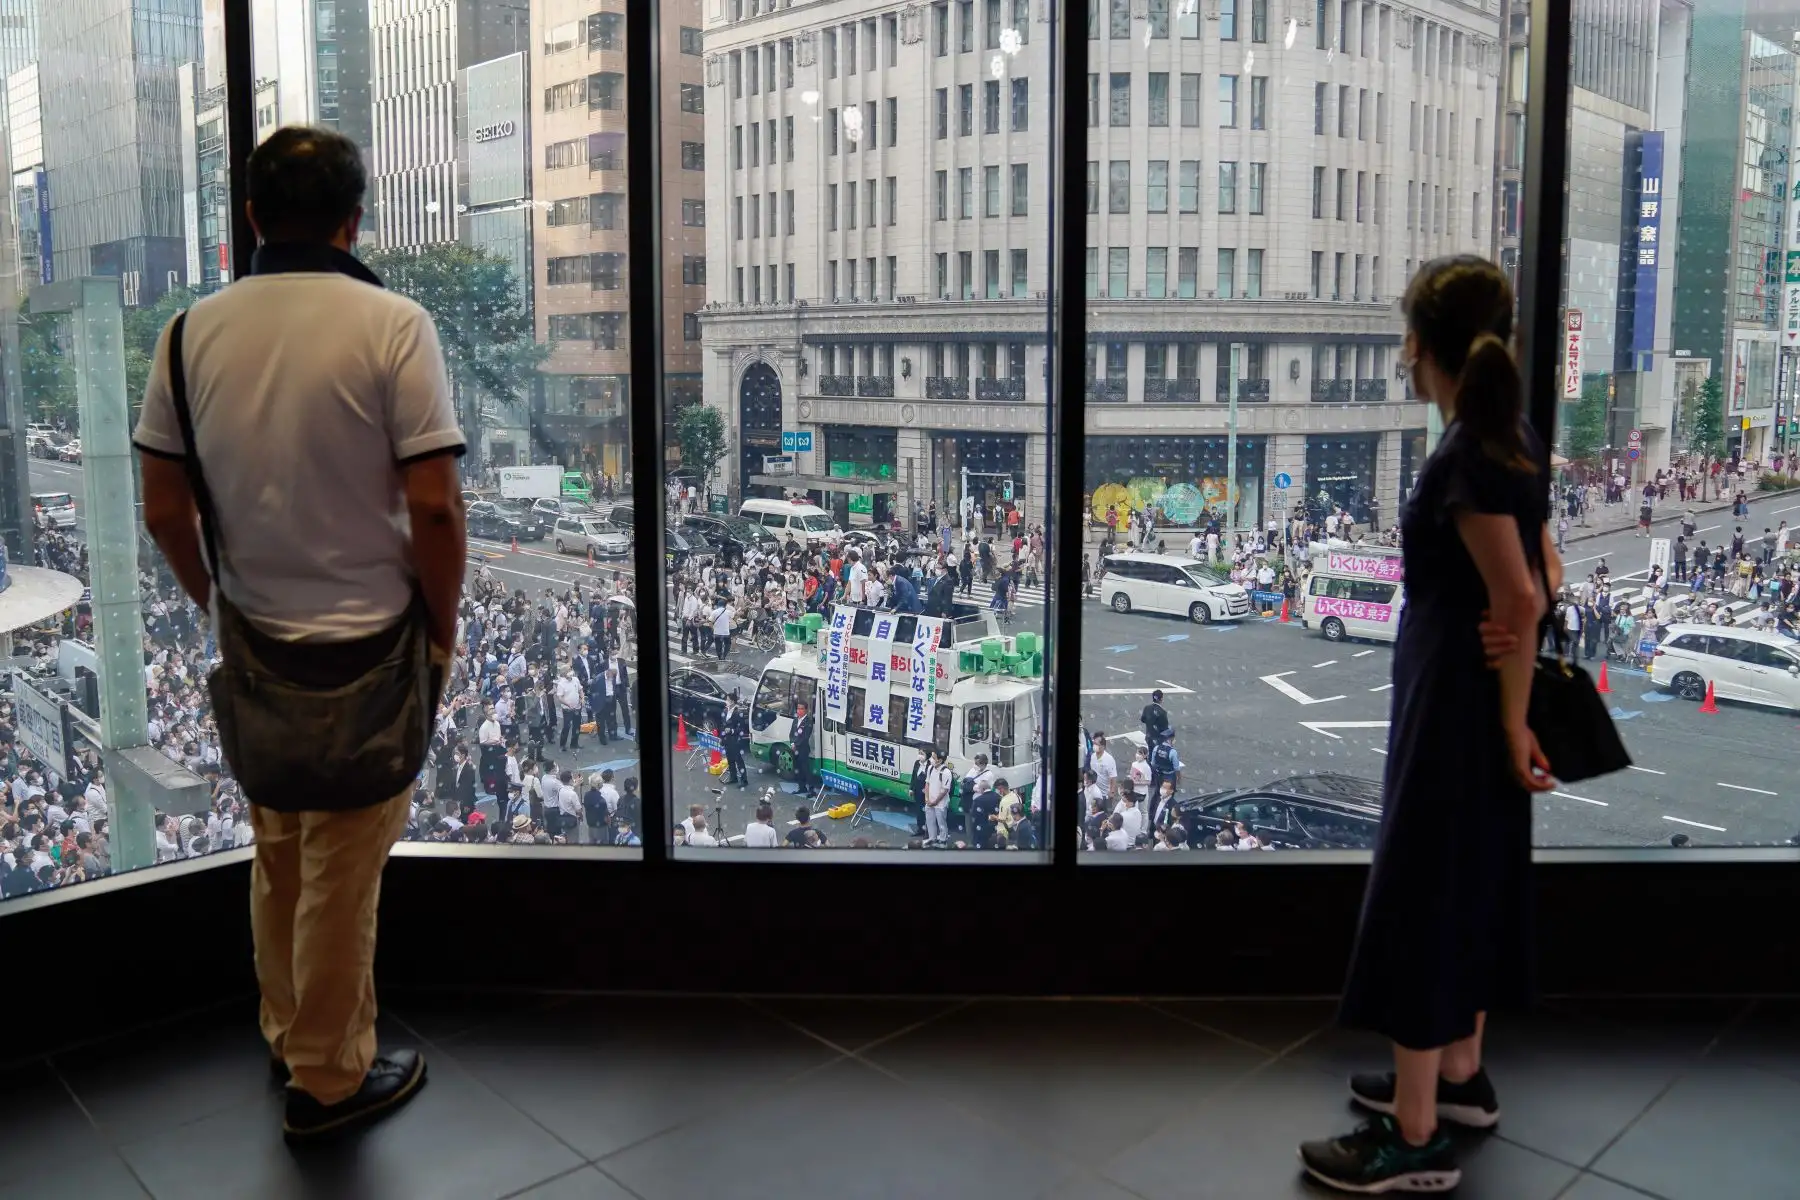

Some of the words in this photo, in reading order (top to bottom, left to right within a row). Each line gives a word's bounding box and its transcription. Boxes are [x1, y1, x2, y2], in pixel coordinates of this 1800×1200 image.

[475, 120, 513, 142] SEIKO
[1639, 177, 1659, 265] 山野楽器
[123, 270, 140, 306] GAP
[1567, 334, 1580, 393] キムラヤのパン
[869, 620, 892, 725] 自民党
[848, 757, 899, 777] www.jimin.jp
[850, 737, 896, 768] 自民党
